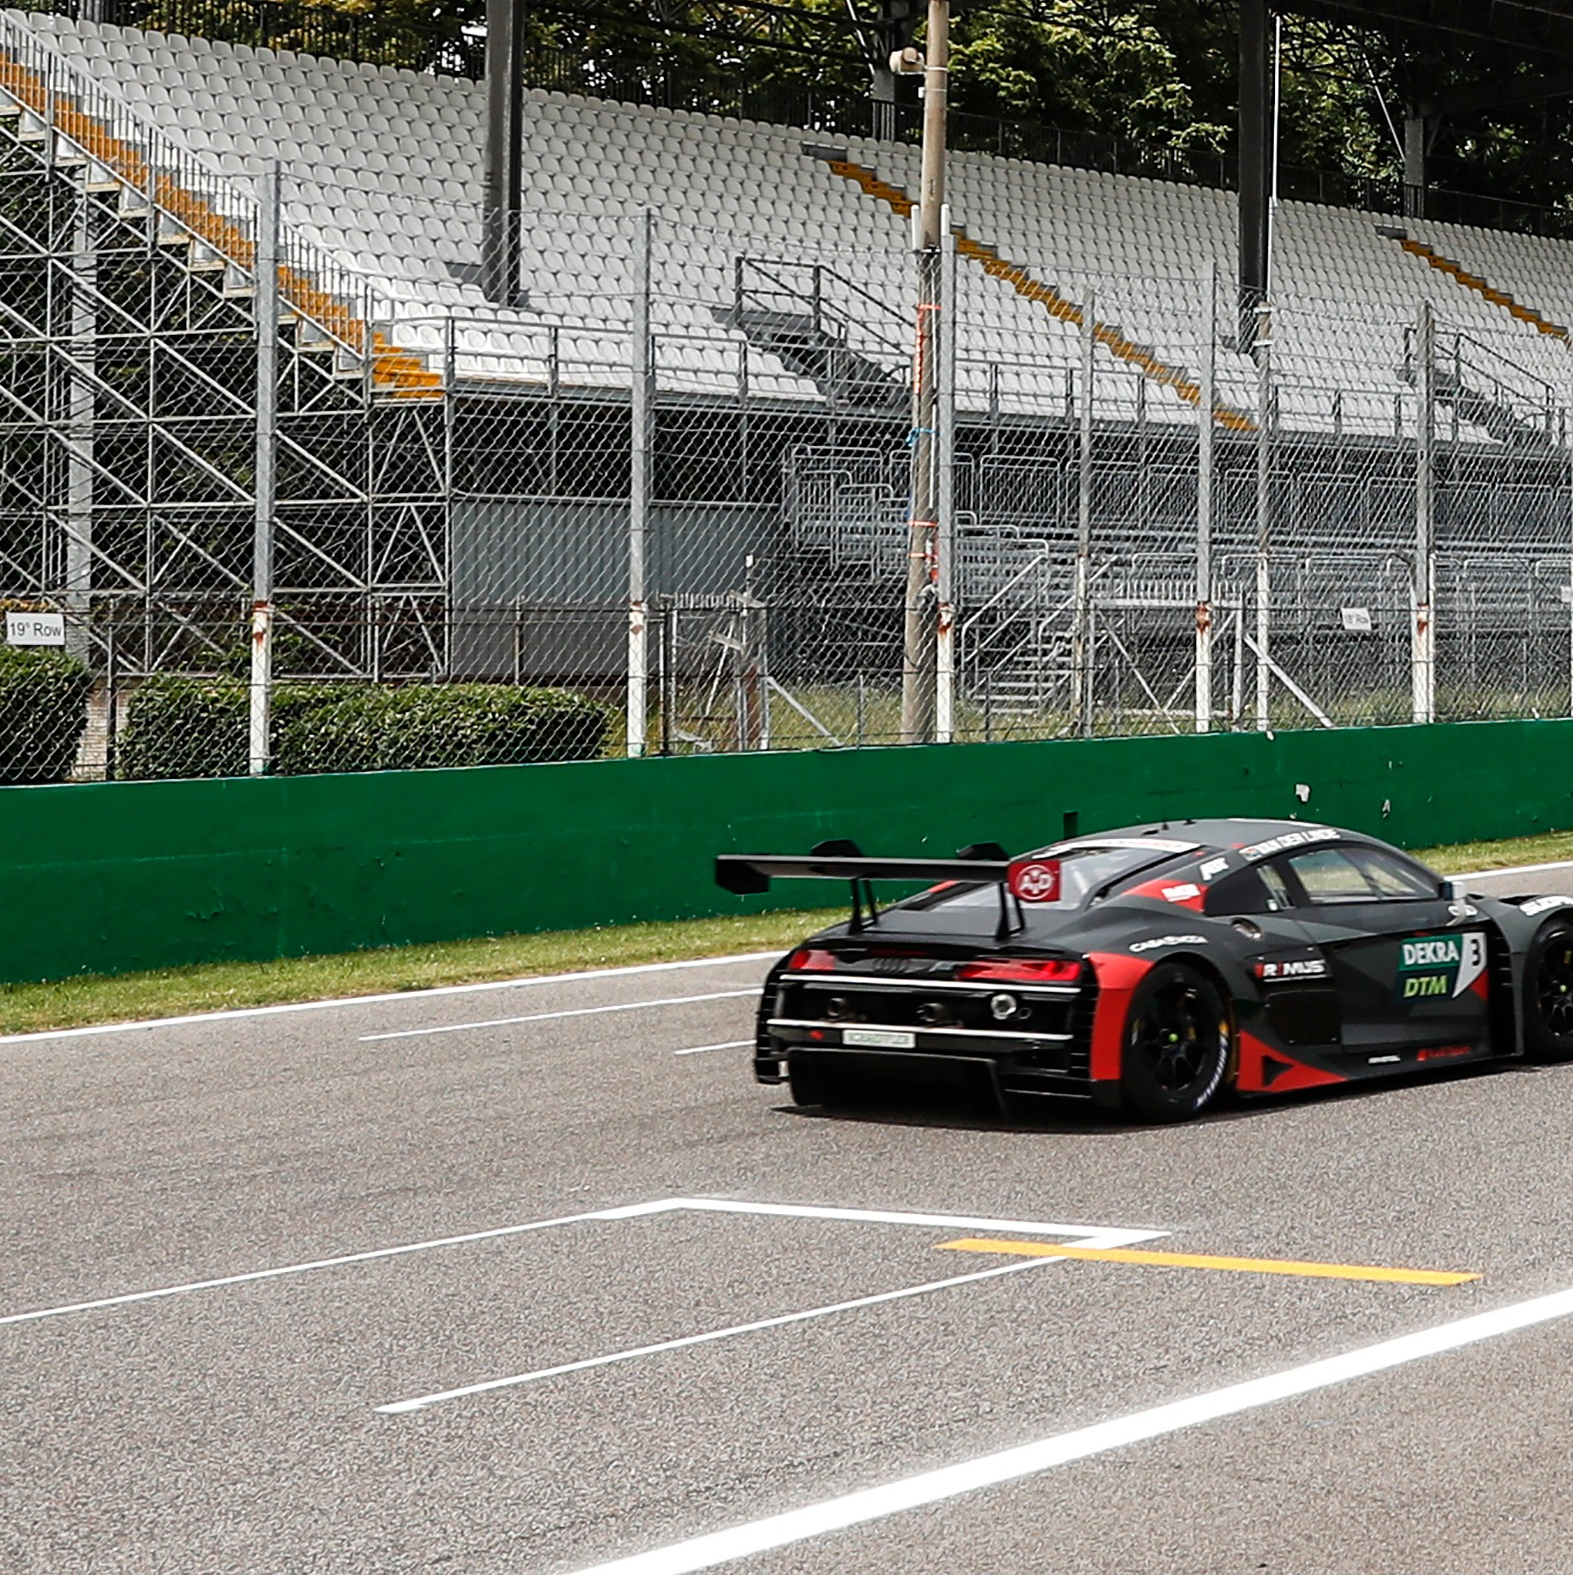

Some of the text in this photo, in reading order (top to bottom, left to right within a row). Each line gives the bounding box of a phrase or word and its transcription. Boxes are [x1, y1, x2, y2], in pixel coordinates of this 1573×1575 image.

[10, 621, 30, 637] 19°
[1402, 938, 1482, 966] DEKRA 3
[1402, 974, 1448, 998] DTM
